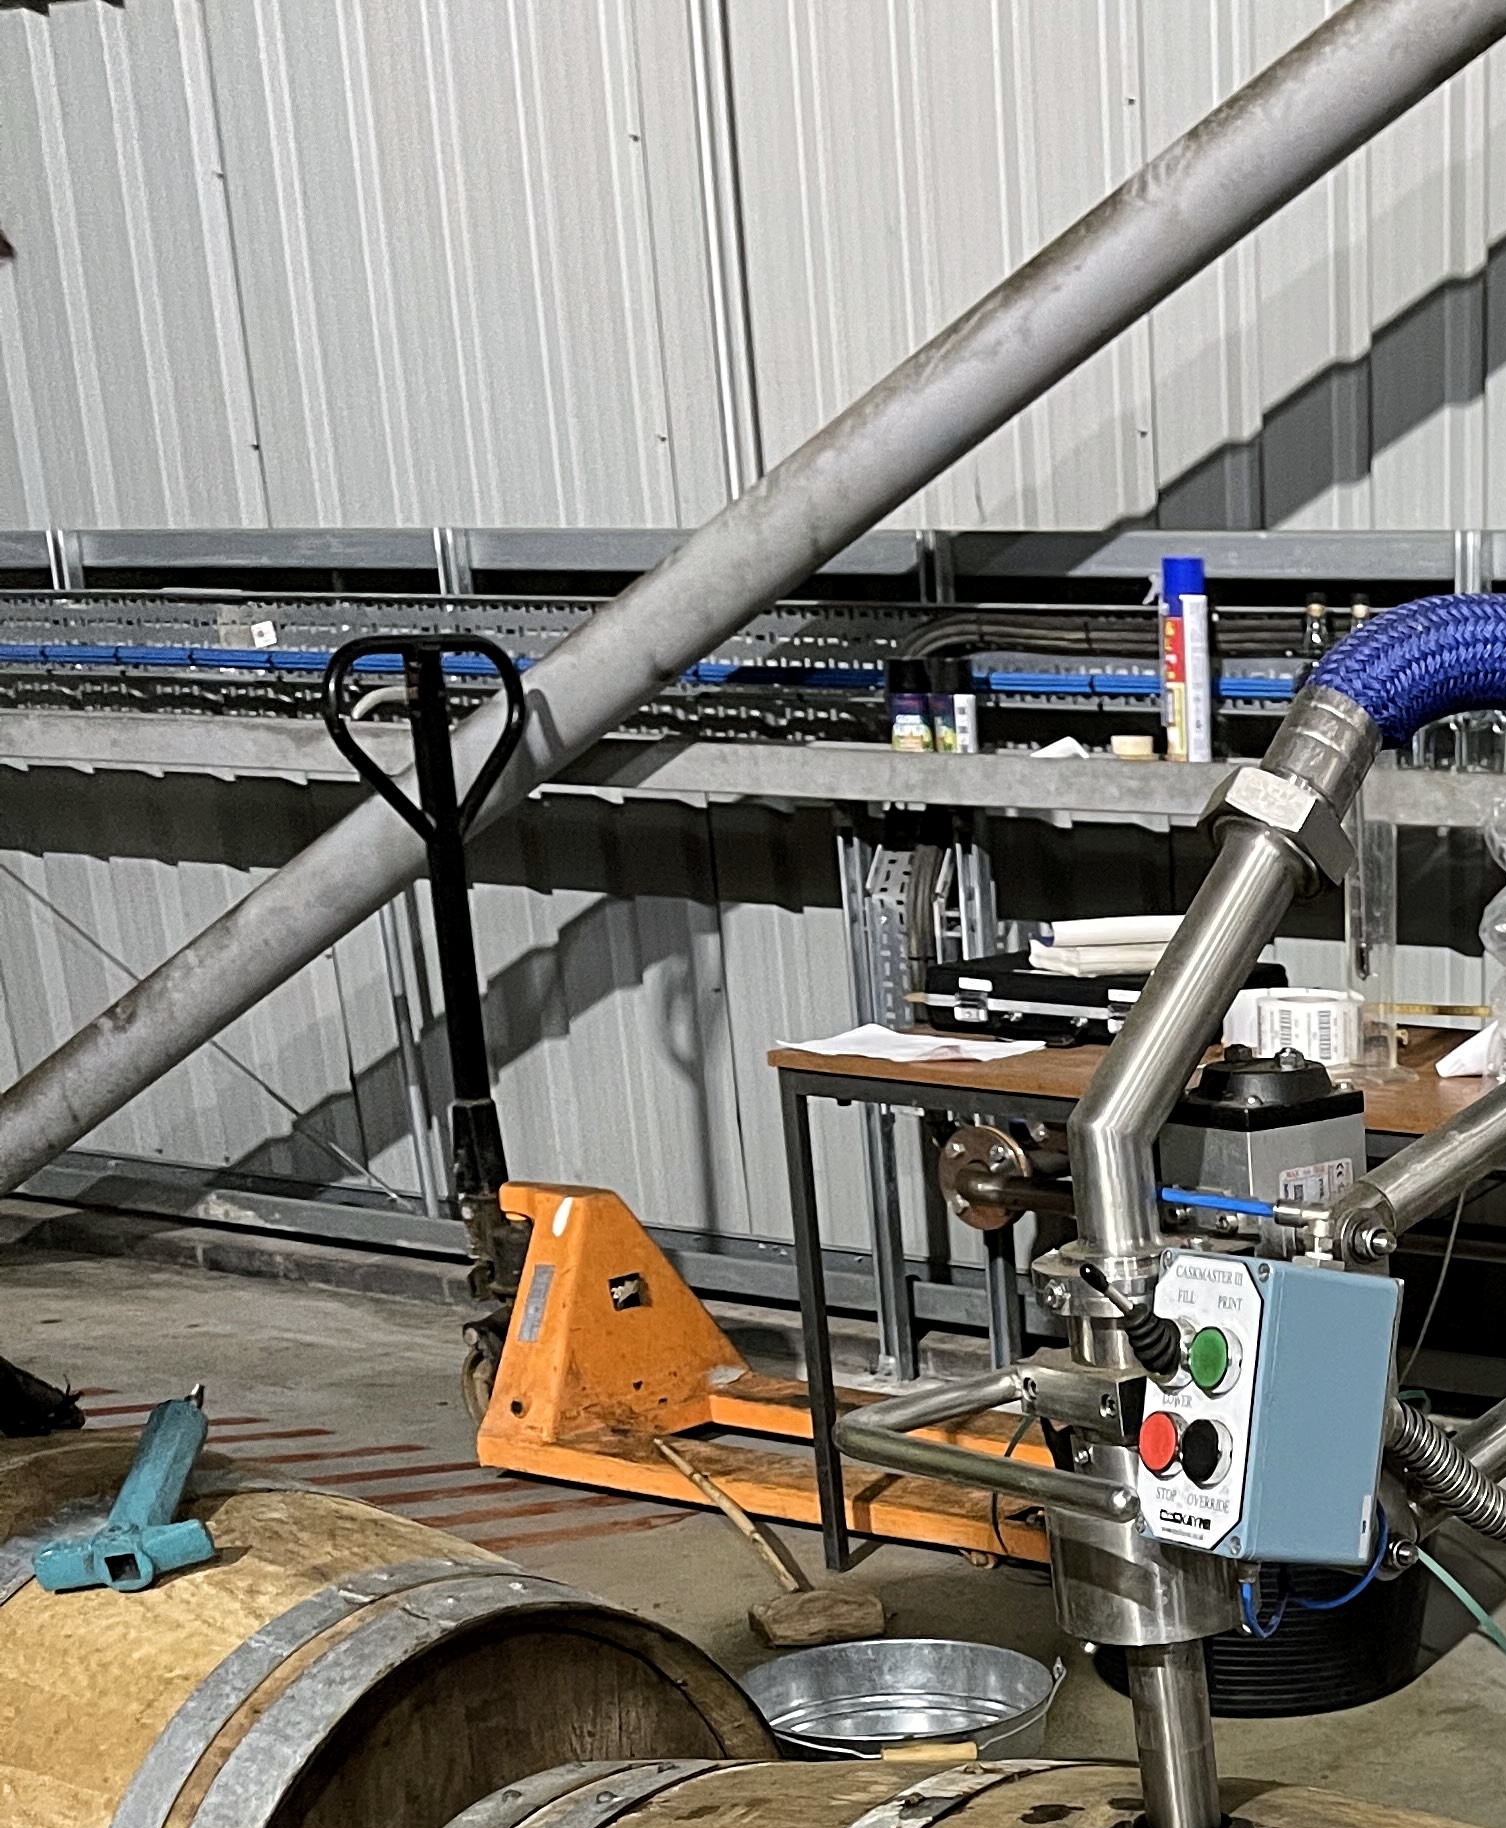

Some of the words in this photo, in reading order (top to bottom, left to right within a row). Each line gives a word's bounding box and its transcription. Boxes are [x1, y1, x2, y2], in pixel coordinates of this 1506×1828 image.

[1176, 1264, 1232, 1284] CASKMASTER
[1177, 1288, 1195, 1304] FILL
[1217, 1295, 1242, 1310] PRINT
[1162, 1394, 1192, 1408] LOWER
[1156, 1487, 1177, 1502] STOP
[1187, 1493, 1230, 1514] OVERRIDE
